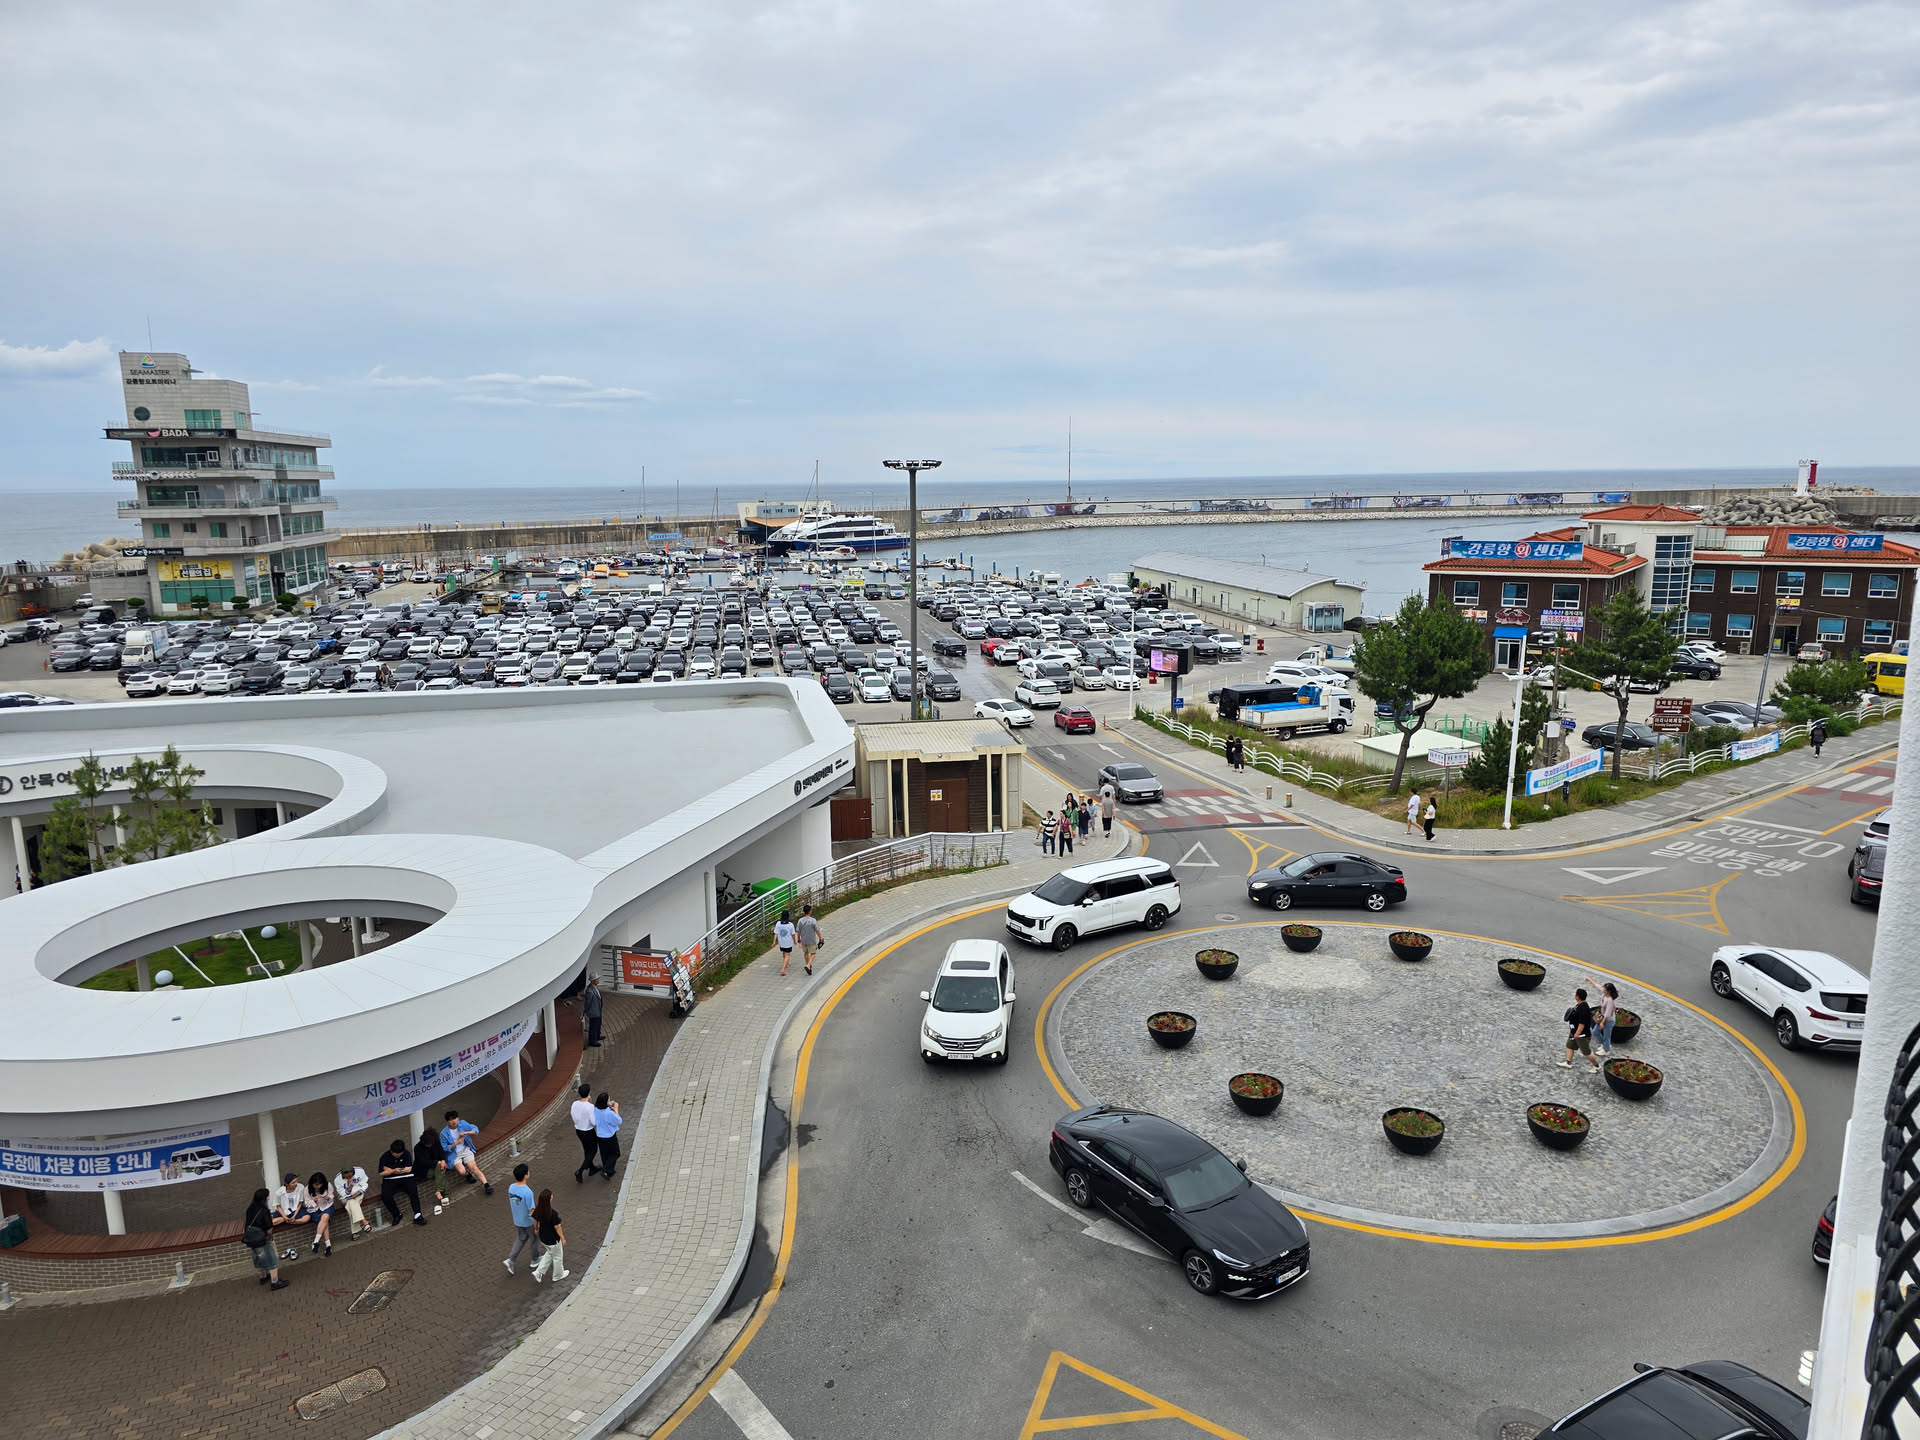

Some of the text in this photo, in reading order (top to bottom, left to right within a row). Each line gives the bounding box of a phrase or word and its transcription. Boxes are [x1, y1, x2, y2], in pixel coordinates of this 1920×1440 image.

[162, 429, 190, 437] BADA
[1467, 543, 1565, 557] 강릉항 회 센터
[1794, 536, 1877, 549] 강릉항 회 센터
[1649, 840, 1808, 877] 일방통행
[363, 1070, 416, 1100] 제8회
[421, 1056, 452, 1081] 안목
[381, 1096, 397, 1108] 일시
[454, 1057, 481, 1077] 10시30분
[457, 1064, 490, 1089] 안목번영회
[2, 1151, 152, 1175] 무장애 차량 이용 안내
